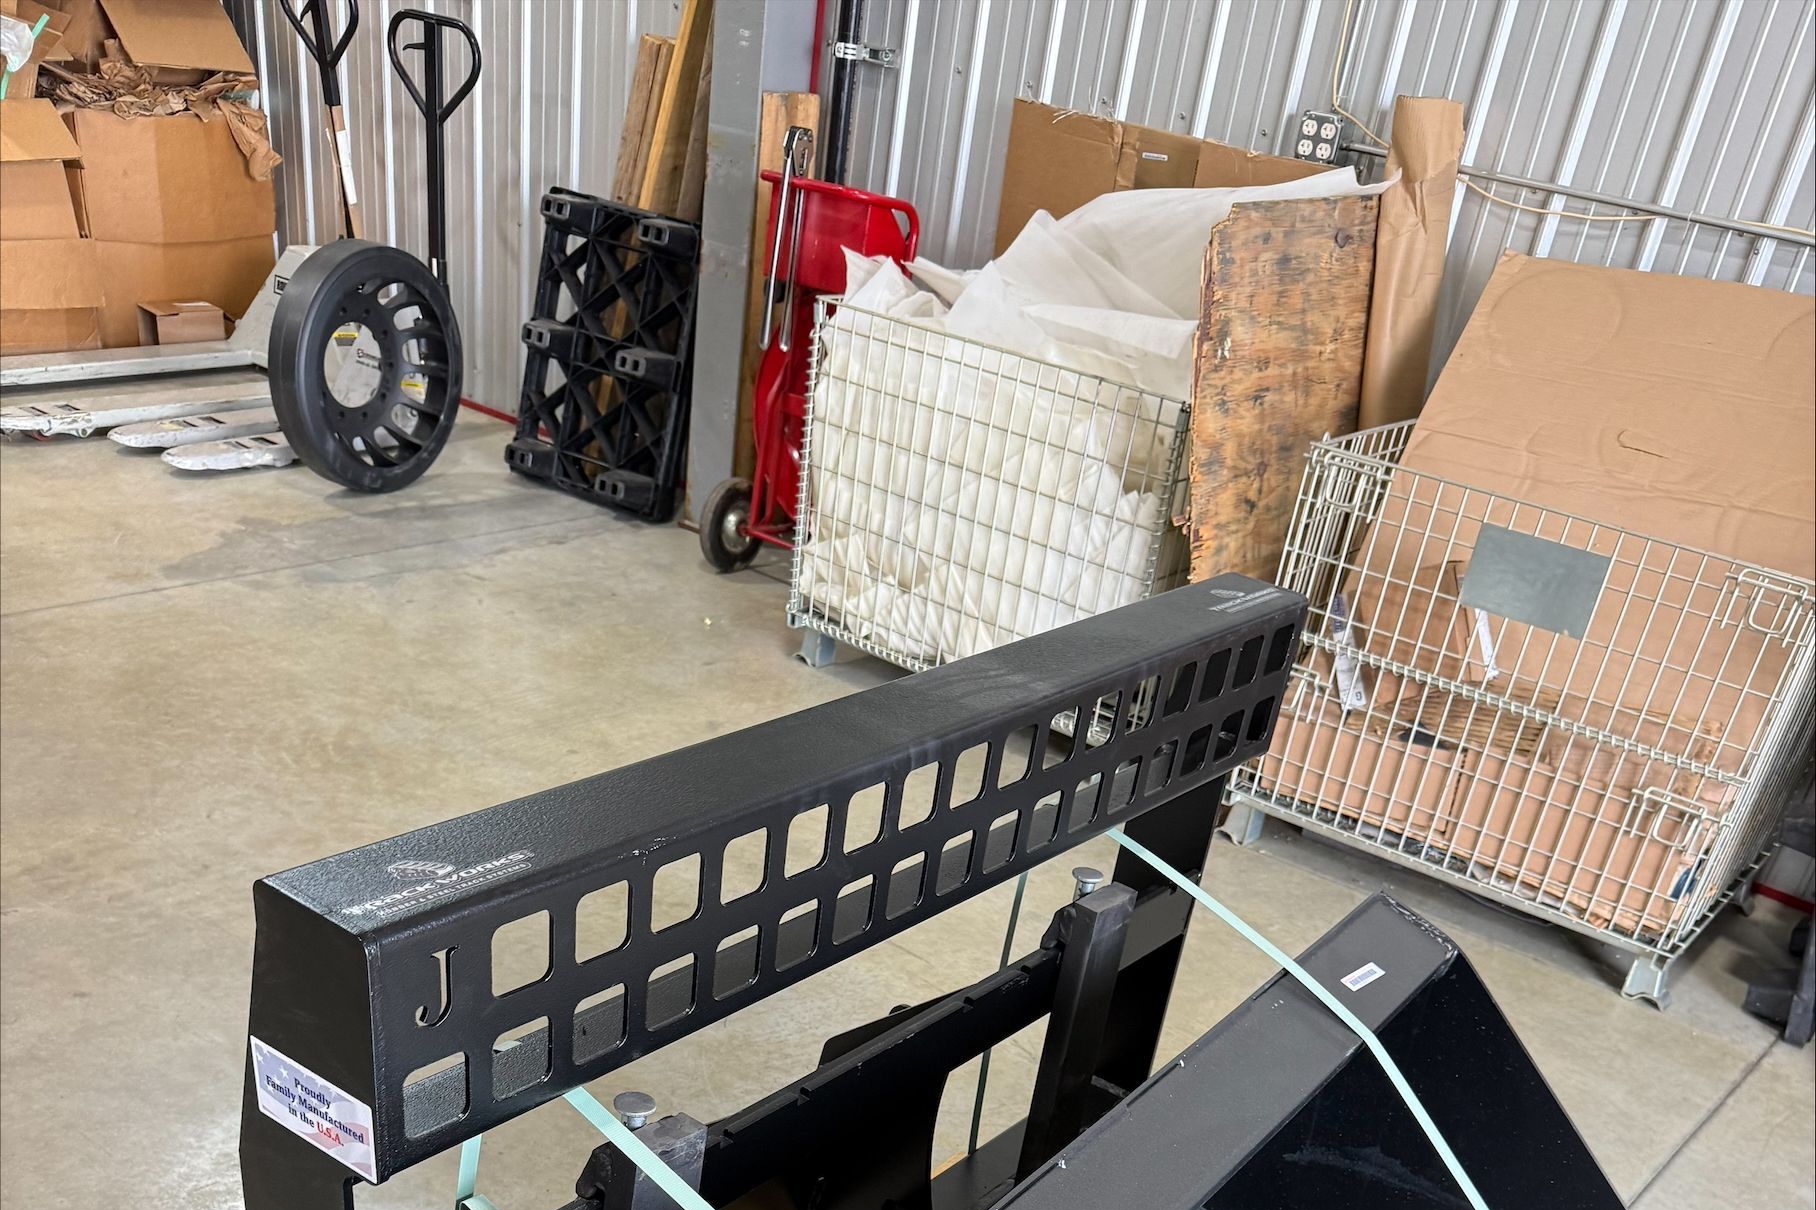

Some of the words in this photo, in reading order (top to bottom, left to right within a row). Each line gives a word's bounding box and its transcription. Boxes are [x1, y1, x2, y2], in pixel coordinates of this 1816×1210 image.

[414, 945, 460, 1029] J
[265, 1075, 297, 1102] Family
[298, 1095, 365, 1144] Manufactured
[294, 1078, 332, 1109] Proudly
[288, 1103, 298, 1117] in
[299, 1111, 315, 1128] the
[316, 1121, 345, 1147] U.S.A.
